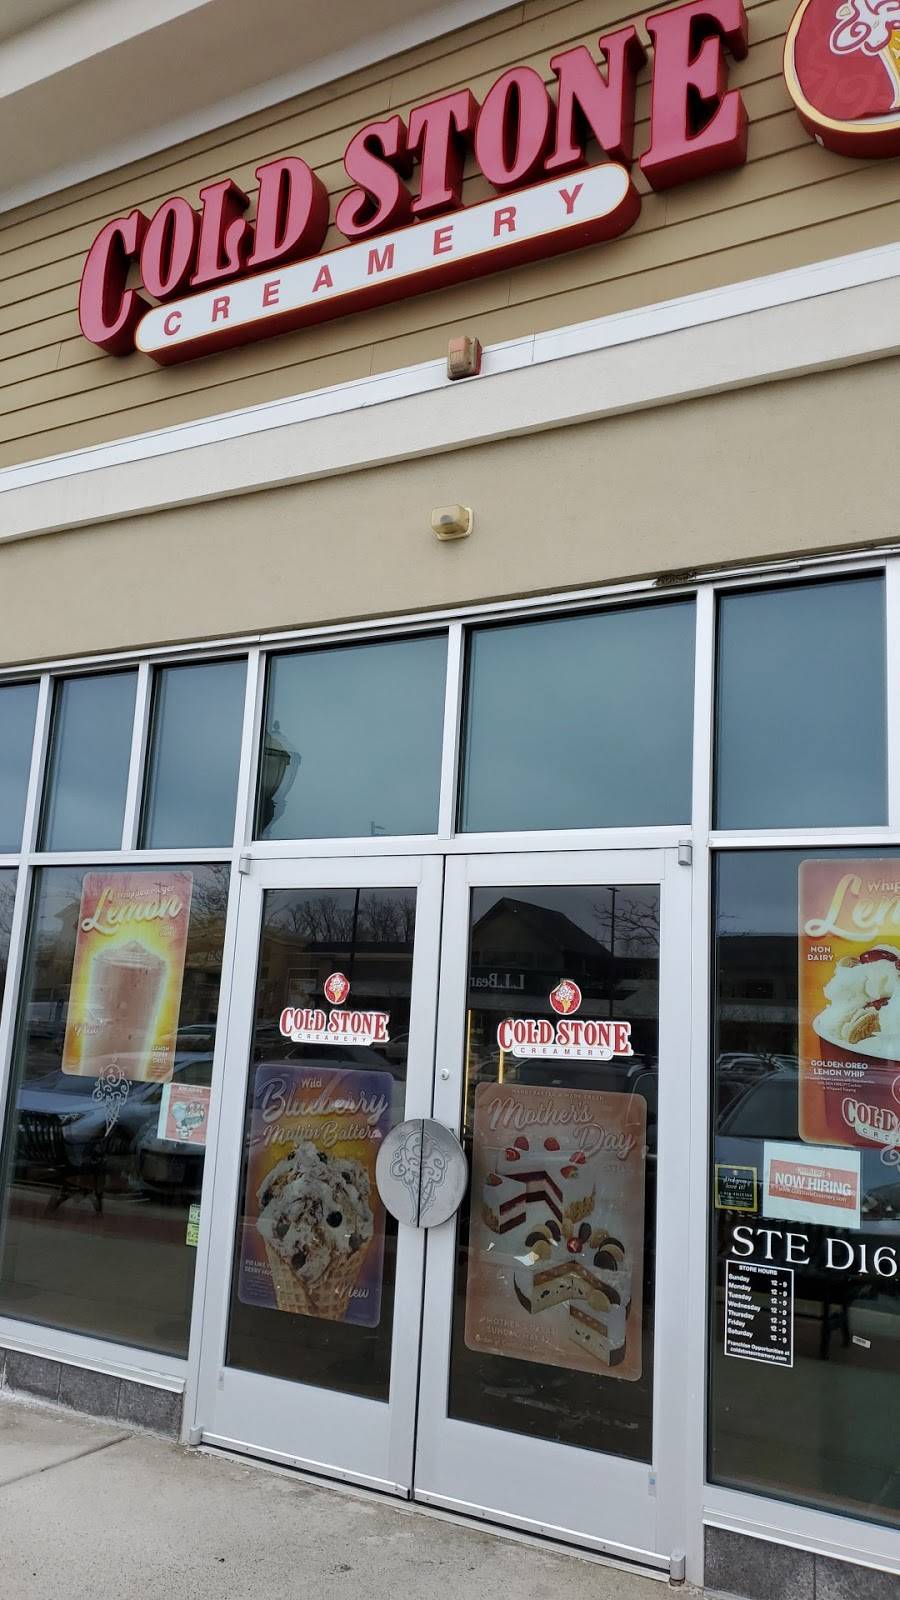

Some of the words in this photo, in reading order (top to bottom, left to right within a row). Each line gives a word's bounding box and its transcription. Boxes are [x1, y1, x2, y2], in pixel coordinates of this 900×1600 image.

[79, 157, 326, 352] COLD
[336, 0, 748, 242] STONE
[163, 183, 584, 336] CREAMERY
[81, 887, 181, 936] Lemon
[280, 1008, 326, 1035] COLD
[328, 1010, 388, 1041] STONE
[298, 1033, 367, 1042] CREAMERY
[498, 1019, 554, 1049] COLD
[556, 1020, 630, 1053] STONE
[520, 1047, 605, 1056] CREAMERY
[811, 1060, 844, 1068] GOLDEN
[845, 1062, 868, 1070] OREO
[813, 1068, 842, 1076] LEMON
[843, 1070, 865, 1078] WHIP
[301, 1079, 322, 1088] Wild
[487, 1097, 593, 1131] Mother's
[842, 1098, 898, 1132] COLD
[573, 1123, 635, 1161] Day
[775, 1172, 805, 1188] NOW
[808, 1178, 852, 1196] HIRING
[731, 1226, 810, 1264] STE
[825, 1238, 898, 1277] D16
[729, 1274, 750, 1282] Sunday
[729, 1282, 751, 1292] Monday
[729, 1292, 752, 1301] Tuesday
[728, 1301, 760, 1312] Wednesday
[728, 1310, 754, 1320] Thursday
[728, 1318, 745, 1328] Friday
[728, 1327, 753, 1338] Saturday
